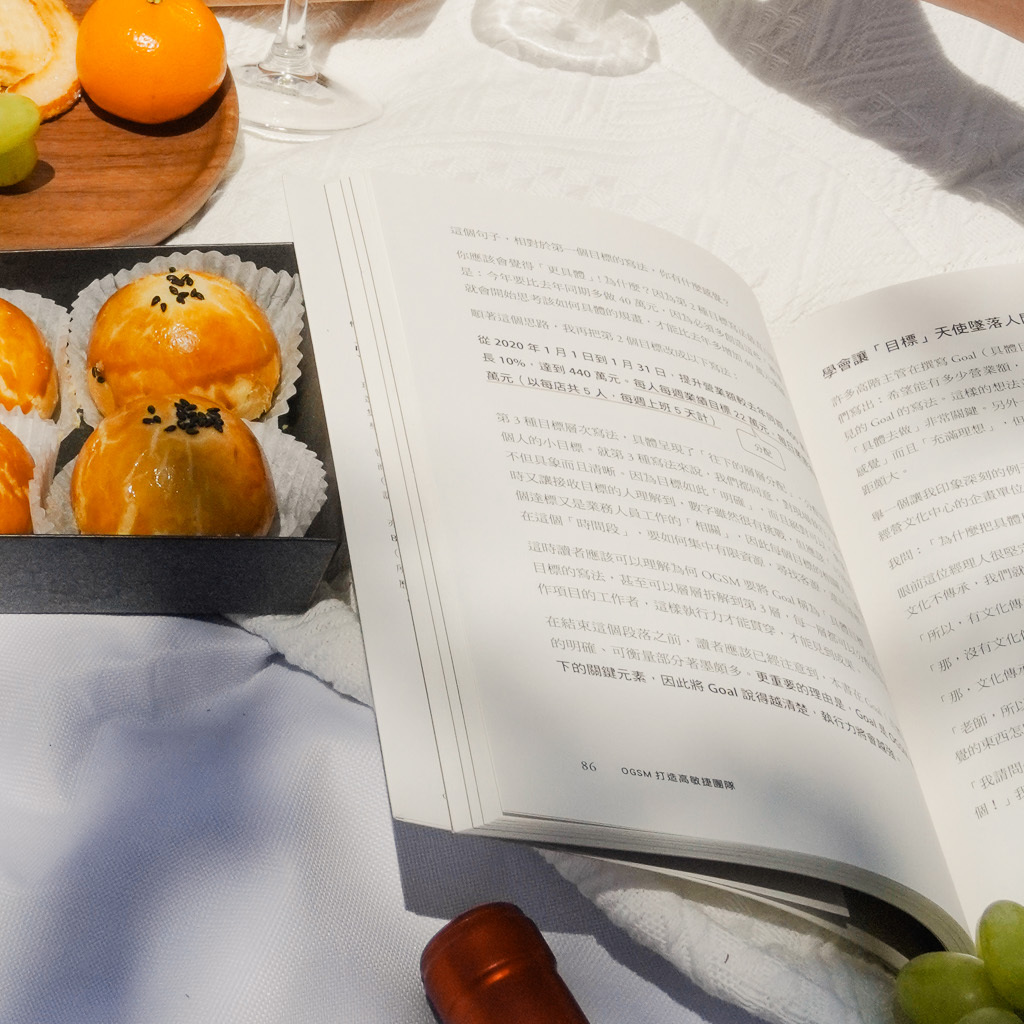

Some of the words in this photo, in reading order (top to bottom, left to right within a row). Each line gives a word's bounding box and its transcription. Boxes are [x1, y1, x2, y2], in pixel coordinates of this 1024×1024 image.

[494, 338, 524, 350] 2020
[951, 352, 977, 364] Goal
[569, 367, 591, 378] 440
[870, 414, 895, 428] Goal
[888, 512, 1024, 570] 我問：「為什麼把具體
[701, 571, 741, 587] OGSM
[772, 589, 794, 605] Goal
[708, 683, 738, 697] Goal
[955, 724, 1024, 765] 覺的東西怎
[581, 760, 597, 772] 86
[621, 766, 652, 778] OGSM
